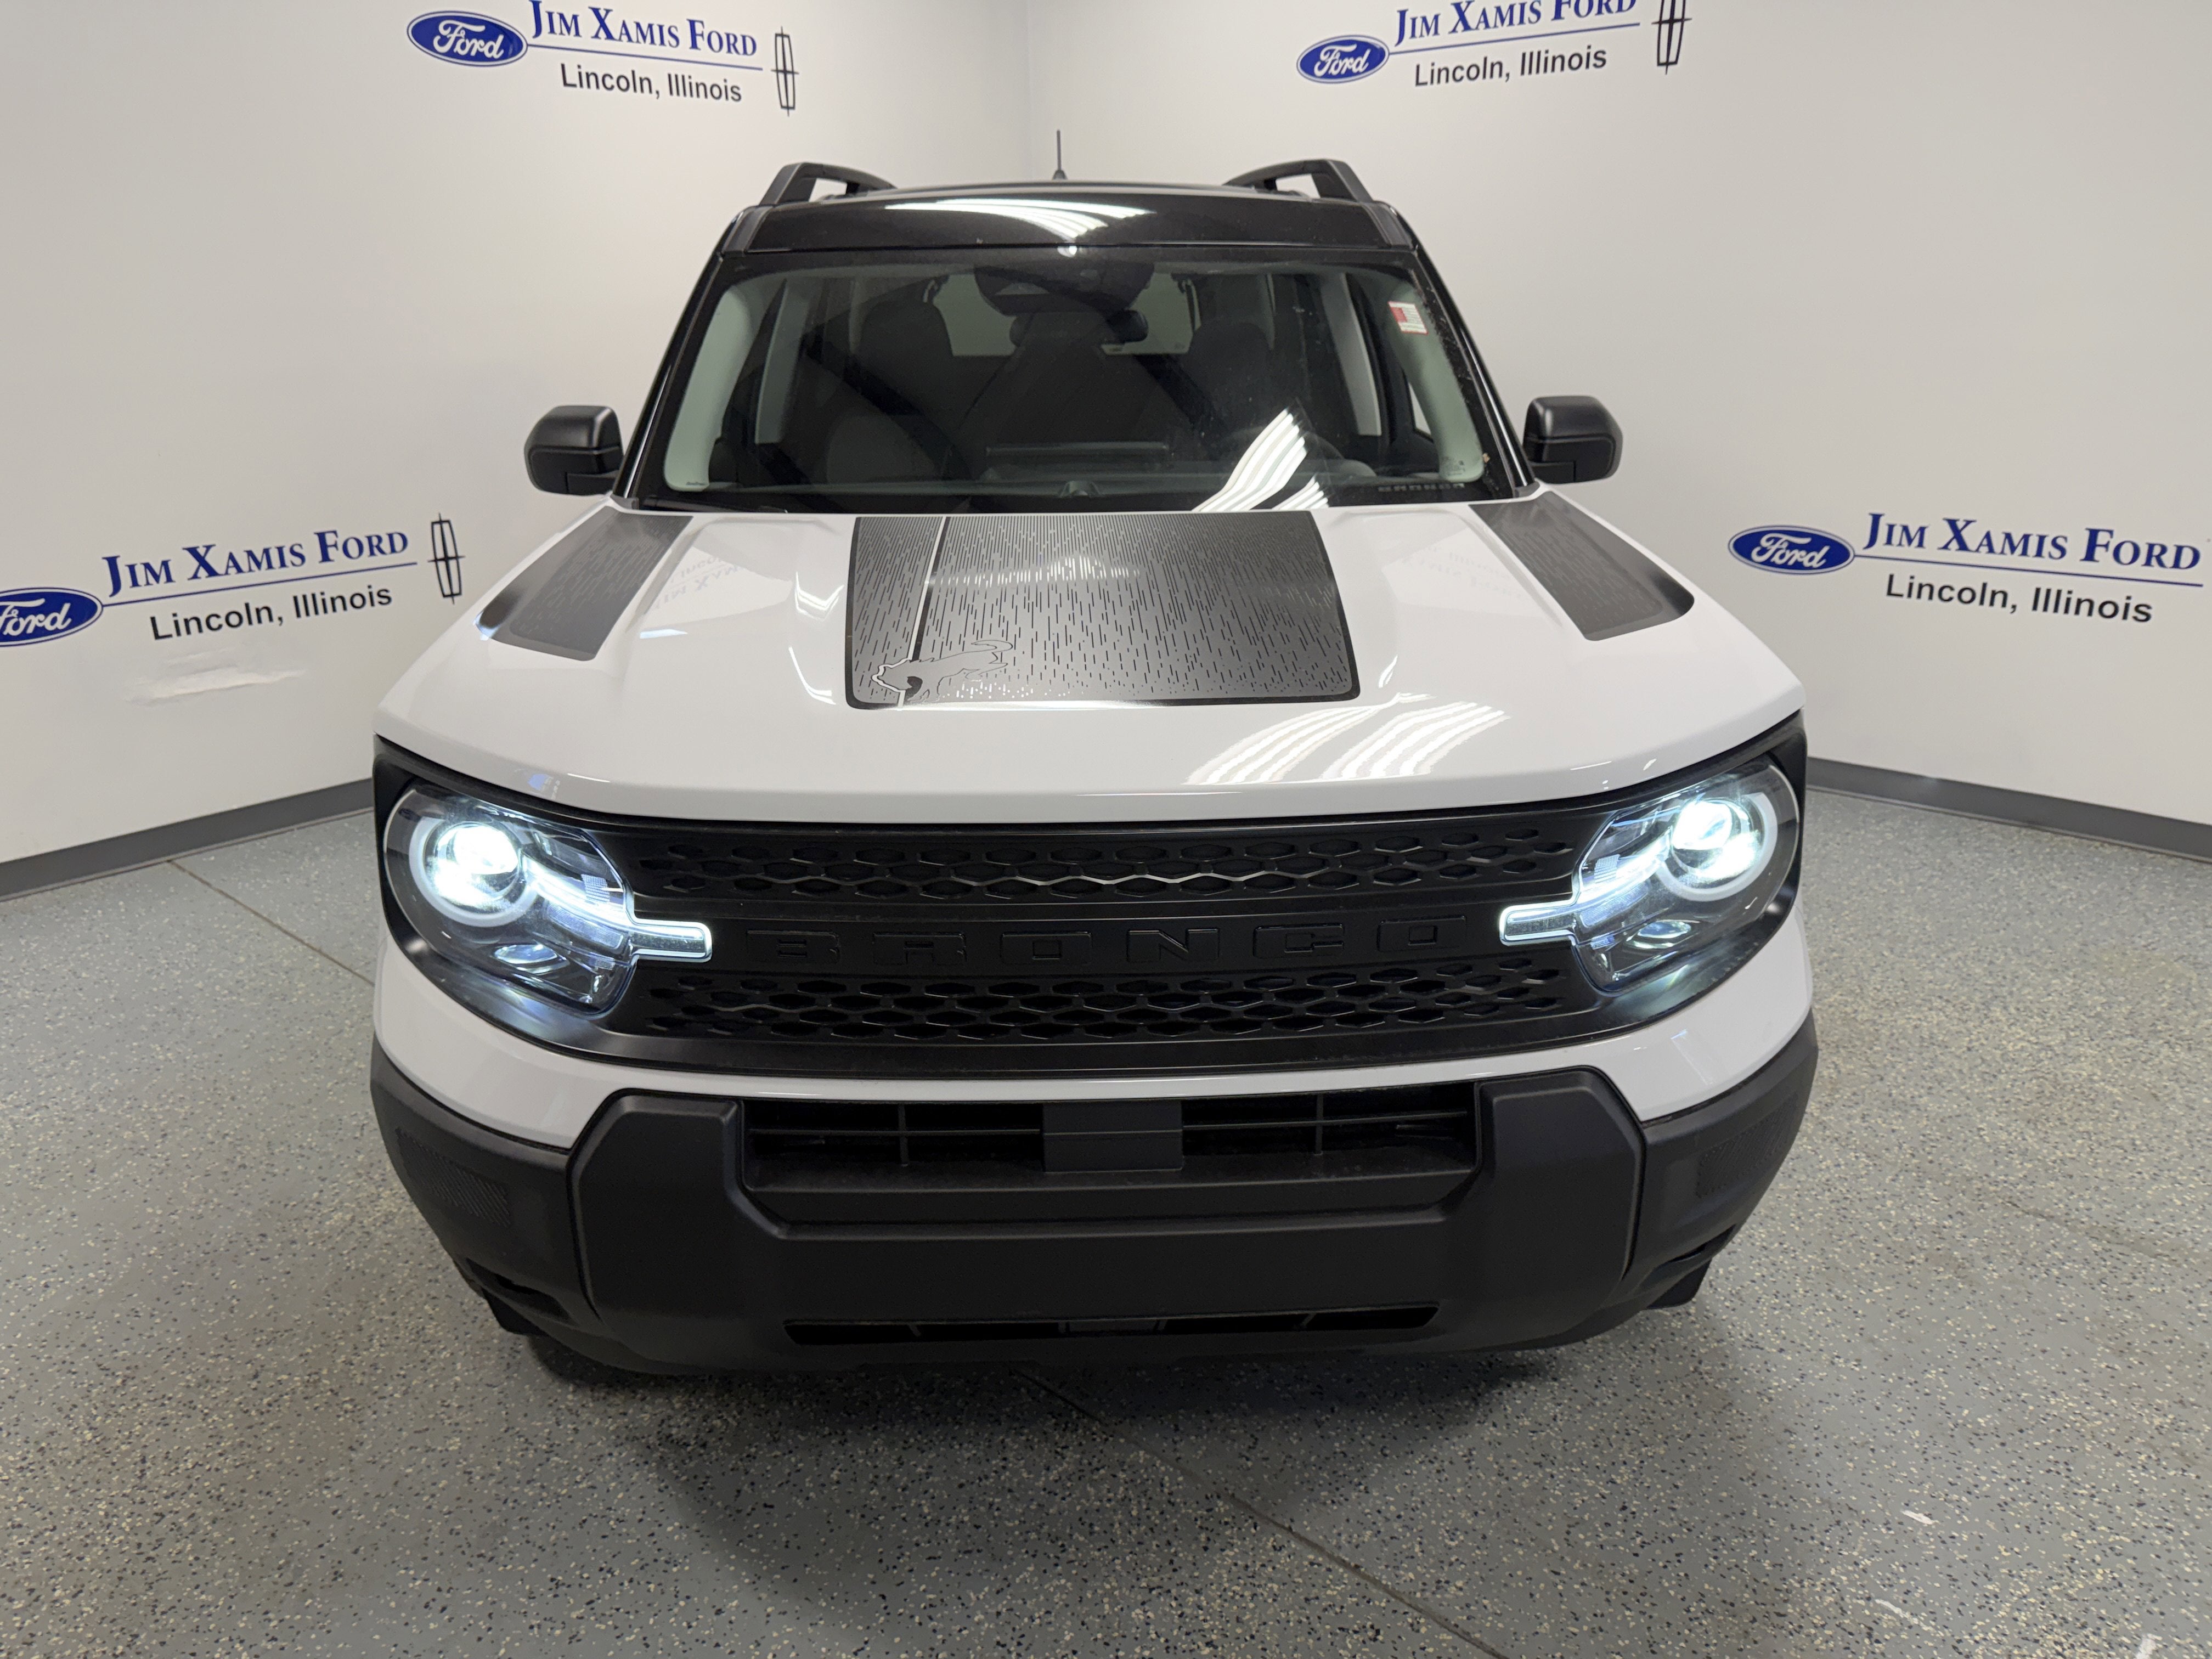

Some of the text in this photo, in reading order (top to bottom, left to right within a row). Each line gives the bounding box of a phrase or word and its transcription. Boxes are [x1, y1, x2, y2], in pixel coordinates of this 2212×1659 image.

[433, 19, 504, 59] Ford
[528, 0, 757, 56] JIM XAMIS FORD
[1395, 9, 1440, 46] JIM
[1449, 0, 1542, 34] XAMIS
[561, 63, 742, 102] Lincoln, Illinois
[1314, 44, 1371, 75] Ford
[1415, 45, 1607, 86] Lincoln, Illinois
[101, 529, 409, 597] JIM XAMIS FORD
[1751, 532, 1831, 569] Ford
[1863, 513, 2201, 570] JIM XAMIS FORD
[150, 585, 393, 641] Lincoln, Illinois
[1885, 574, 2153, 623] Lincoln, Illinois
[744, 916, 1468, 964] BRONCO
